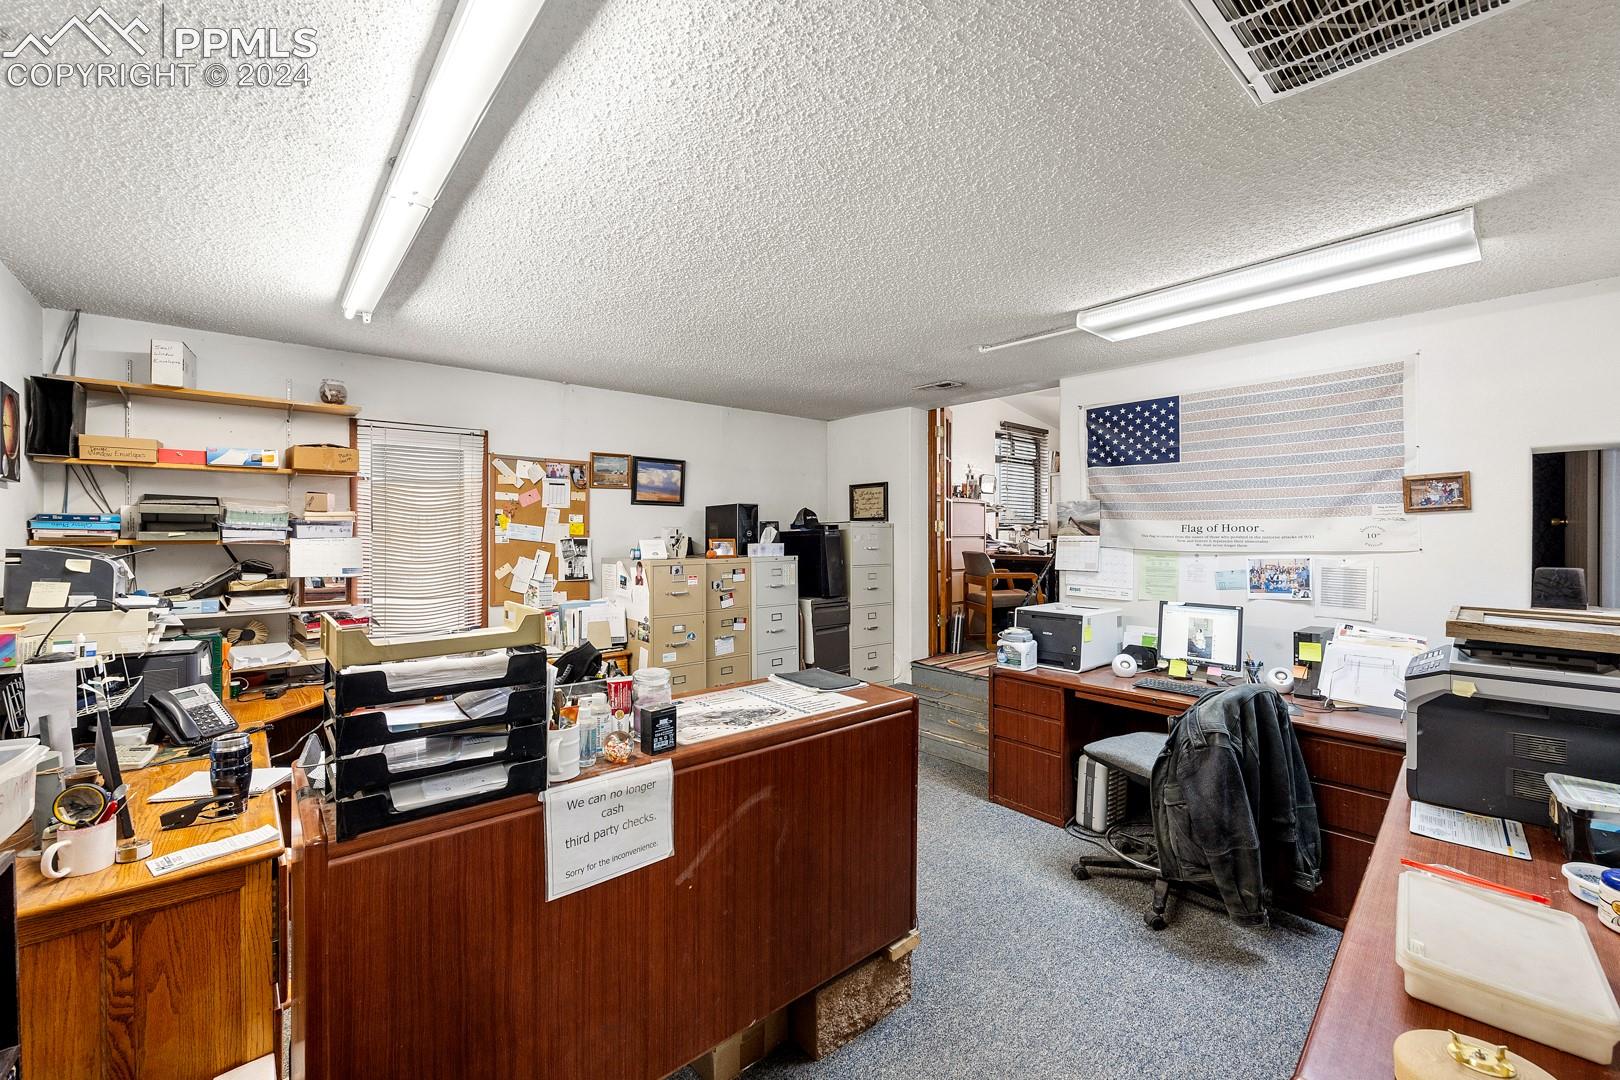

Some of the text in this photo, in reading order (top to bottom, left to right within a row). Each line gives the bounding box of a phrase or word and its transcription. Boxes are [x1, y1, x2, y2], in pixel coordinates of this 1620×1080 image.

[1181, 523, 1260, 534] Flag of Honor
[566, 780, 657, 811] We can no longer
[601, 803, 624, 818] cash
[565, 812, 657, 849] third party checks.
[565, 841, 658, 879] Sorry for the inconvenience.
